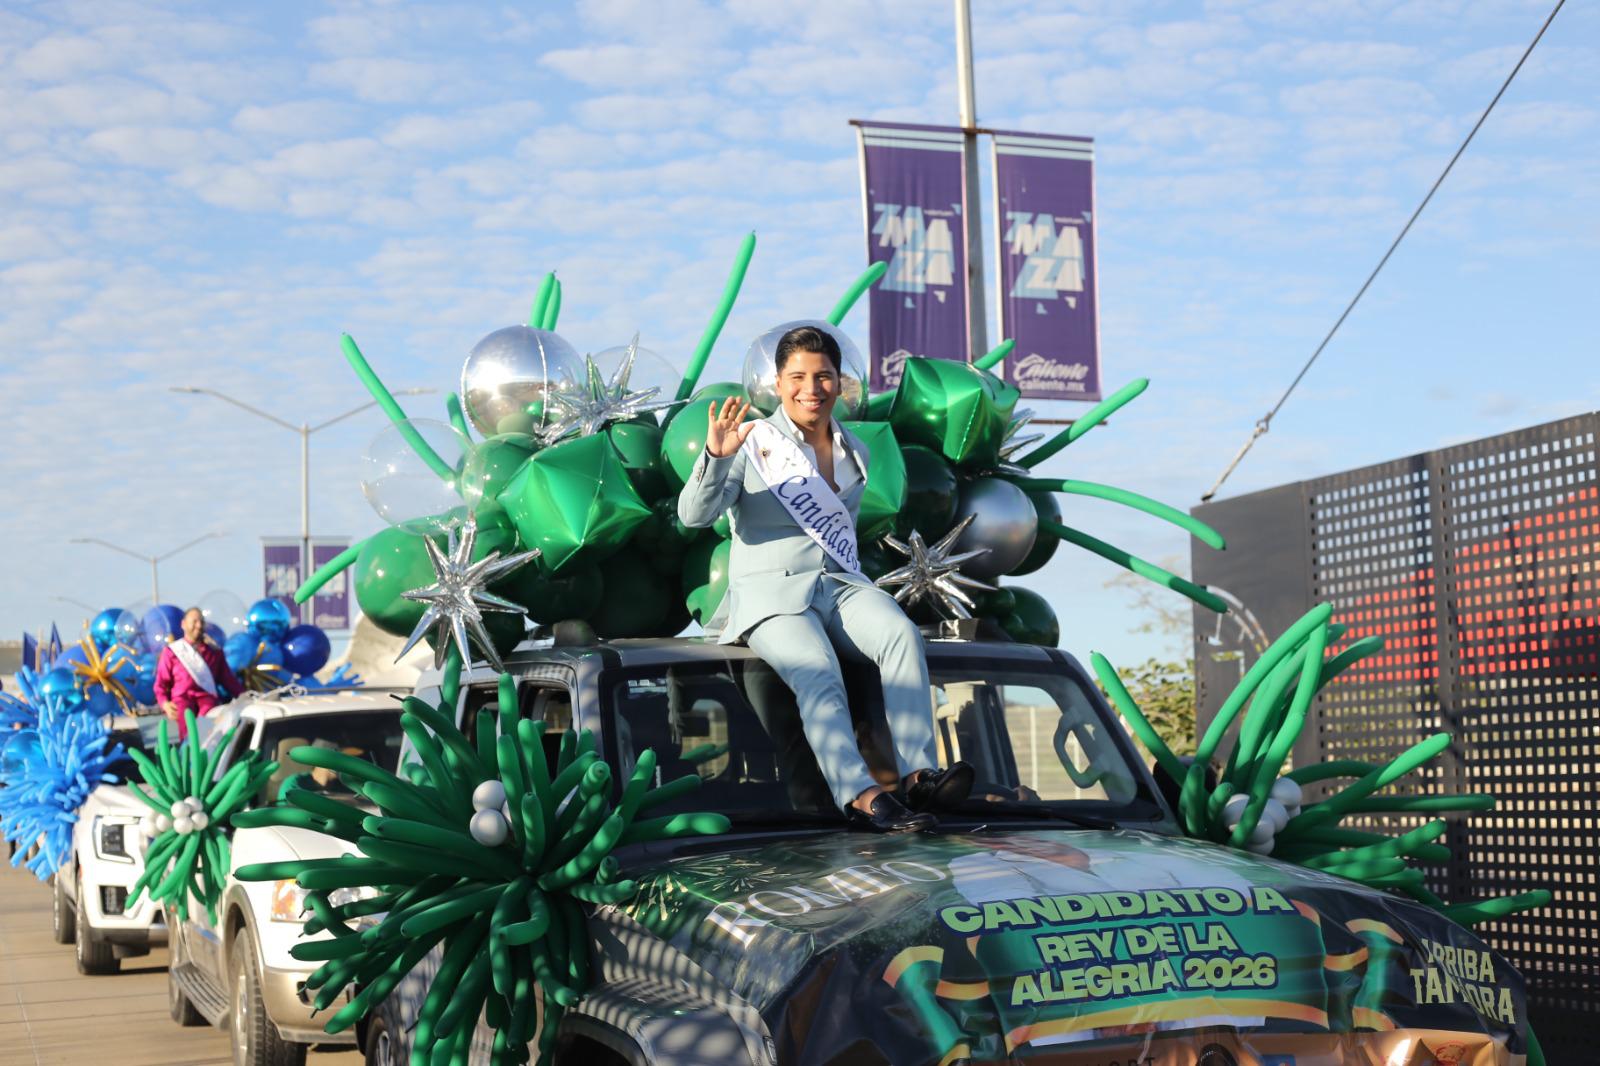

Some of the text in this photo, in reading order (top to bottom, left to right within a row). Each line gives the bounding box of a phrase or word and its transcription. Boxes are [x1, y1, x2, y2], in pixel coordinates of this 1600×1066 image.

[704, 861, 947, 950] ROMEO
[941, 886, 1294, 933] CANDIDATO A
[1035, 924, 1239, 964] REY DE LA
[1010, 955, 1278, 1006] ALEGRIA 2026
[1409, 967, 1516, 1024] TAMORA
